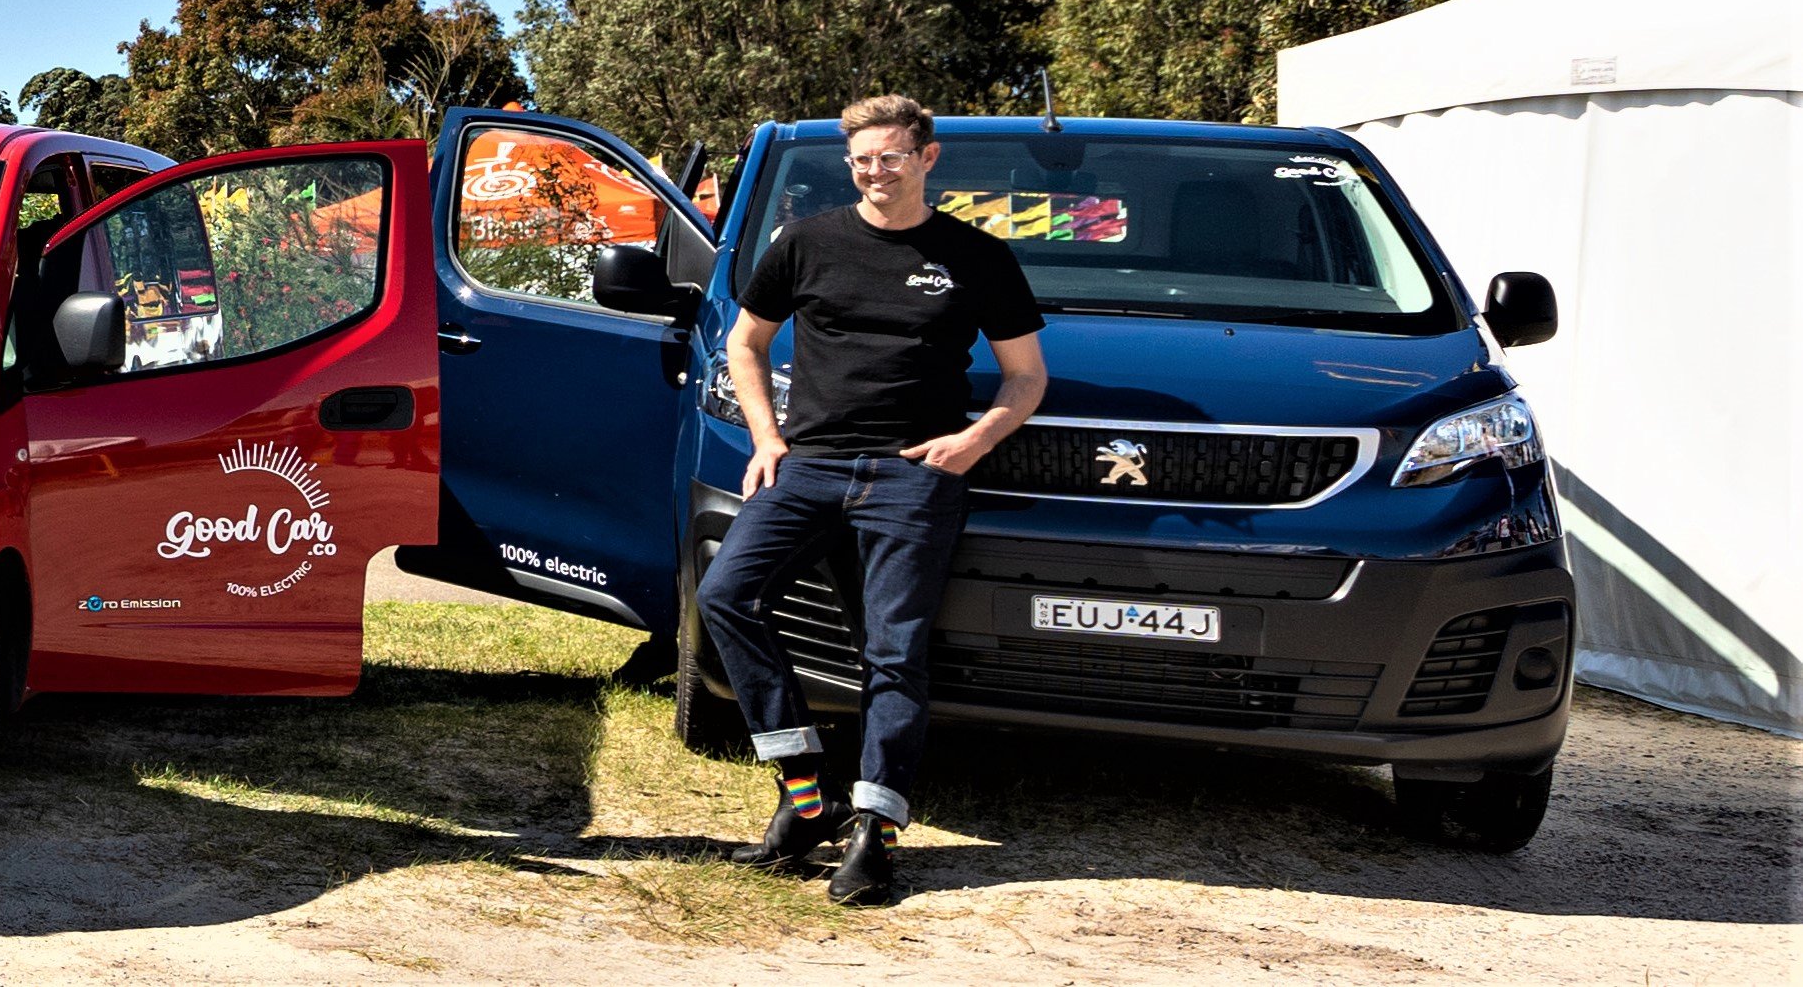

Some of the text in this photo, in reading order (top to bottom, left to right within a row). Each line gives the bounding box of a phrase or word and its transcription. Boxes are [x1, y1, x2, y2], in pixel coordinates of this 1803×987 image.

[157, 504, 334, 559] Good Car
[226, 560, 312, 598] 100% ELECTRIC
[499, 543, 607, 586] 100% electric
[121, 598, 181, 609] Emission
